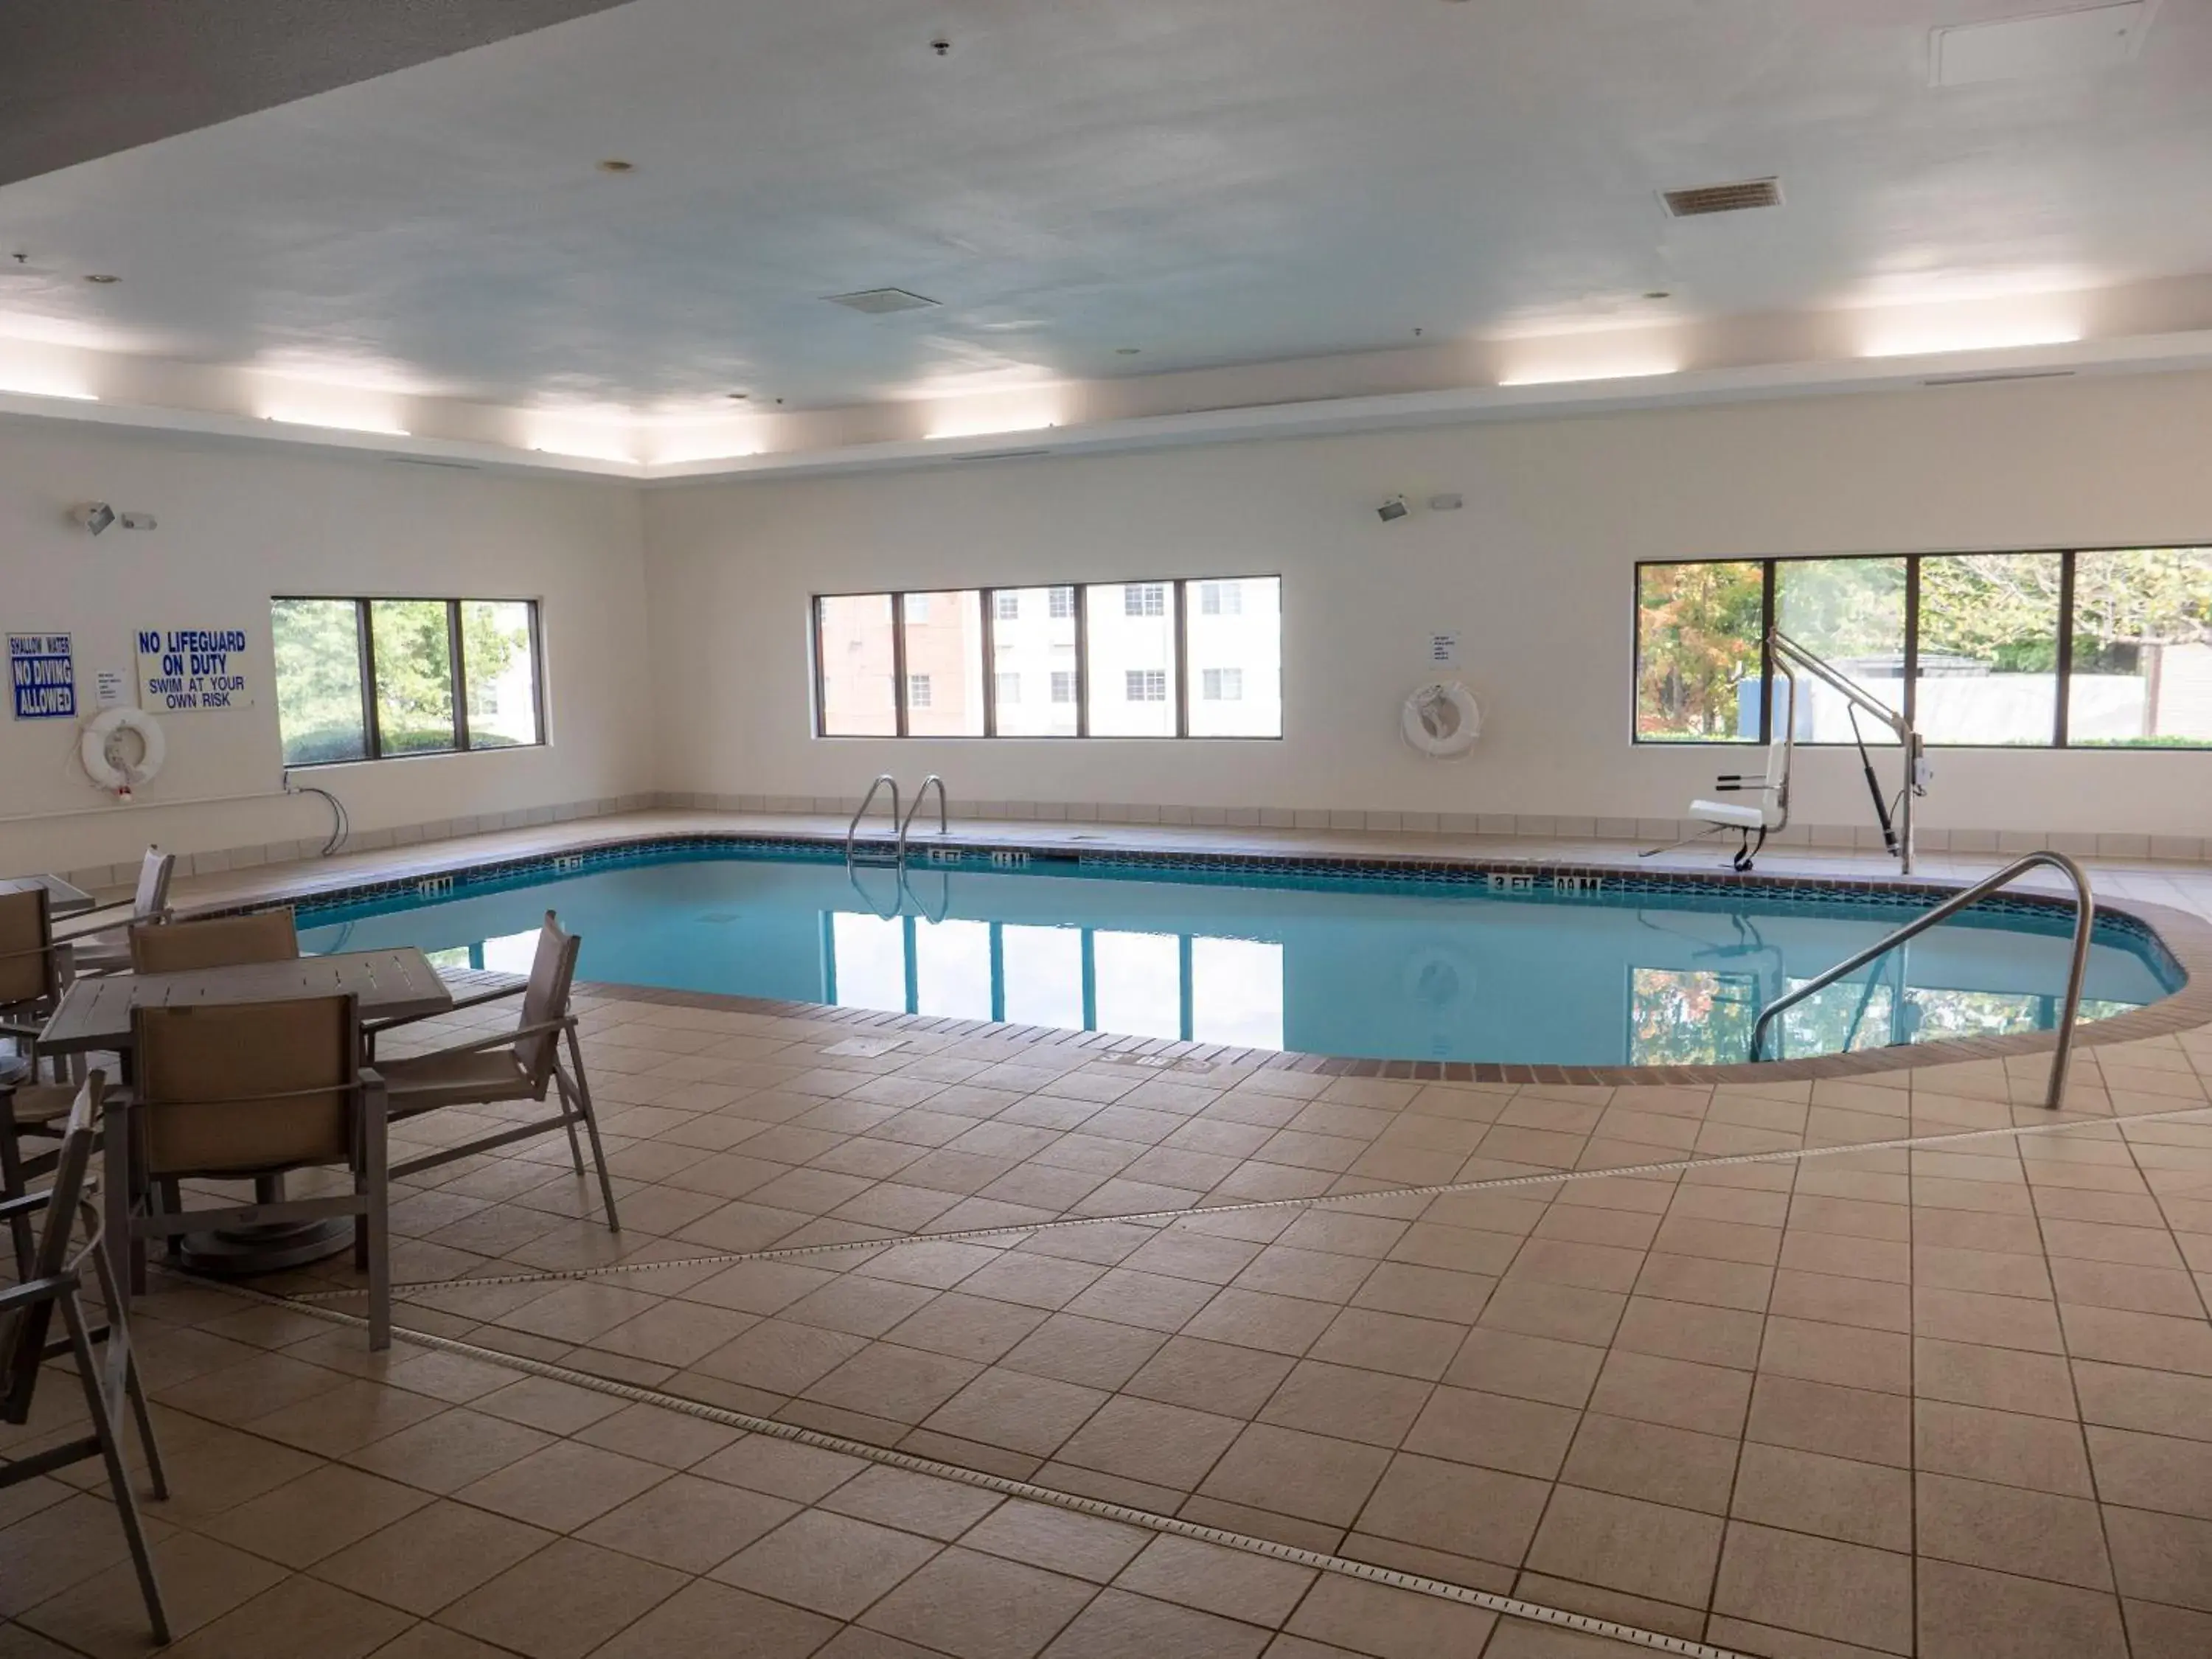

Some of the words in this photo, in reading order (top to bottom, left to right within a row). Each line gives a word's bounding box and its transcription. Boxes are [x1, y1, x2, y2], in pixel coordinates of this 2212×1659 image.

[10, 636, 42, 655] SHALLOW
[46, 636, 70, 654] WATER
[139, 632, 160, 653] NO
[167, 630, 246, 652] LIFEGUARD
[15, 660, 32, 686] NO
[33, 658, 72, 685] DIVING
[163, 654, 184, 675] ON
[190, 654, 226, 675] DUTY
[150, 678, 182, 694] SWIM
[189, 678, 204, 692] AT
[210, 676, 244, 691] YOUR
[21, 687, 72, 714] ALLOWED
[166, 694, 197, 709] OWN
[202, 692, 231, 707] RISK
